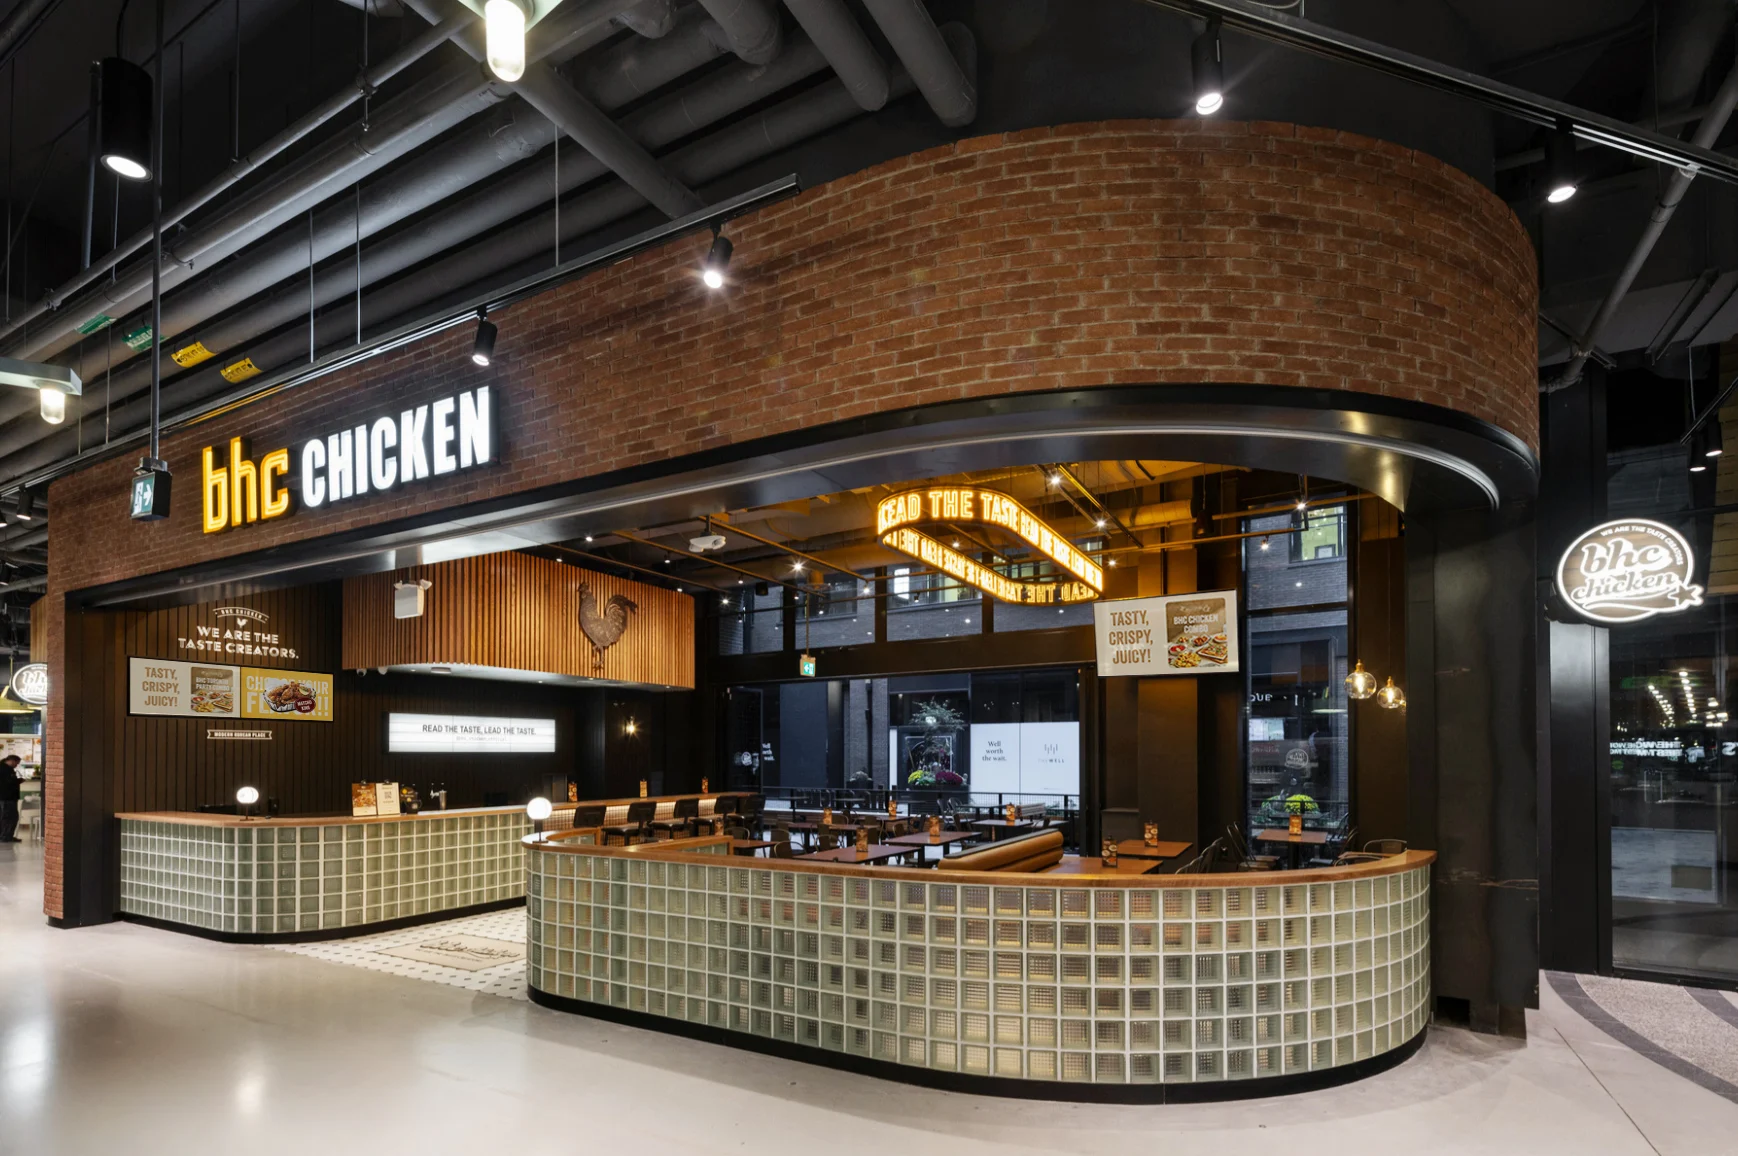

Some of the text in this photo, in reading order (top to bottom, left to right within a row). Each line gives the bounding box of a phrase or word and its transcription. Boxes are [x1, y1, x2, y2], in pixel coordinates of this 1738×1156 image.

[202, 386, 490, 534] bhc CHICKEN
[928, 490, 974, 518] THE
[980, 492, 1018, 533] TASTE
[1581, 538, 1672, 577] bhc
[1572, 569, 1679, 603] chicken
[1110, 610, 1149, 626] TASTY,
[1188, 614, 1219, 624] CHICKEN
[197, 625, 279, 645] WE ARE THE
[1109, 629, 1153, 646] CRISPY,
[178, 637, 299, 659] TASTE CREATORS.
[1113, 649, 1151, 664] JUICY!
[145, 666, 178, 681] TASTY,
[142, 681, 180, 694] CRISPY,
[145, 695, 178, 707] JUICY!
[422, 724, 443, 733] READ
[445, 725, 458, 733] THE
[460, 725, 483, 735] TASTE,
[484, 726, 501, 734] LEAD
[503, 727, 515, 735] THE
